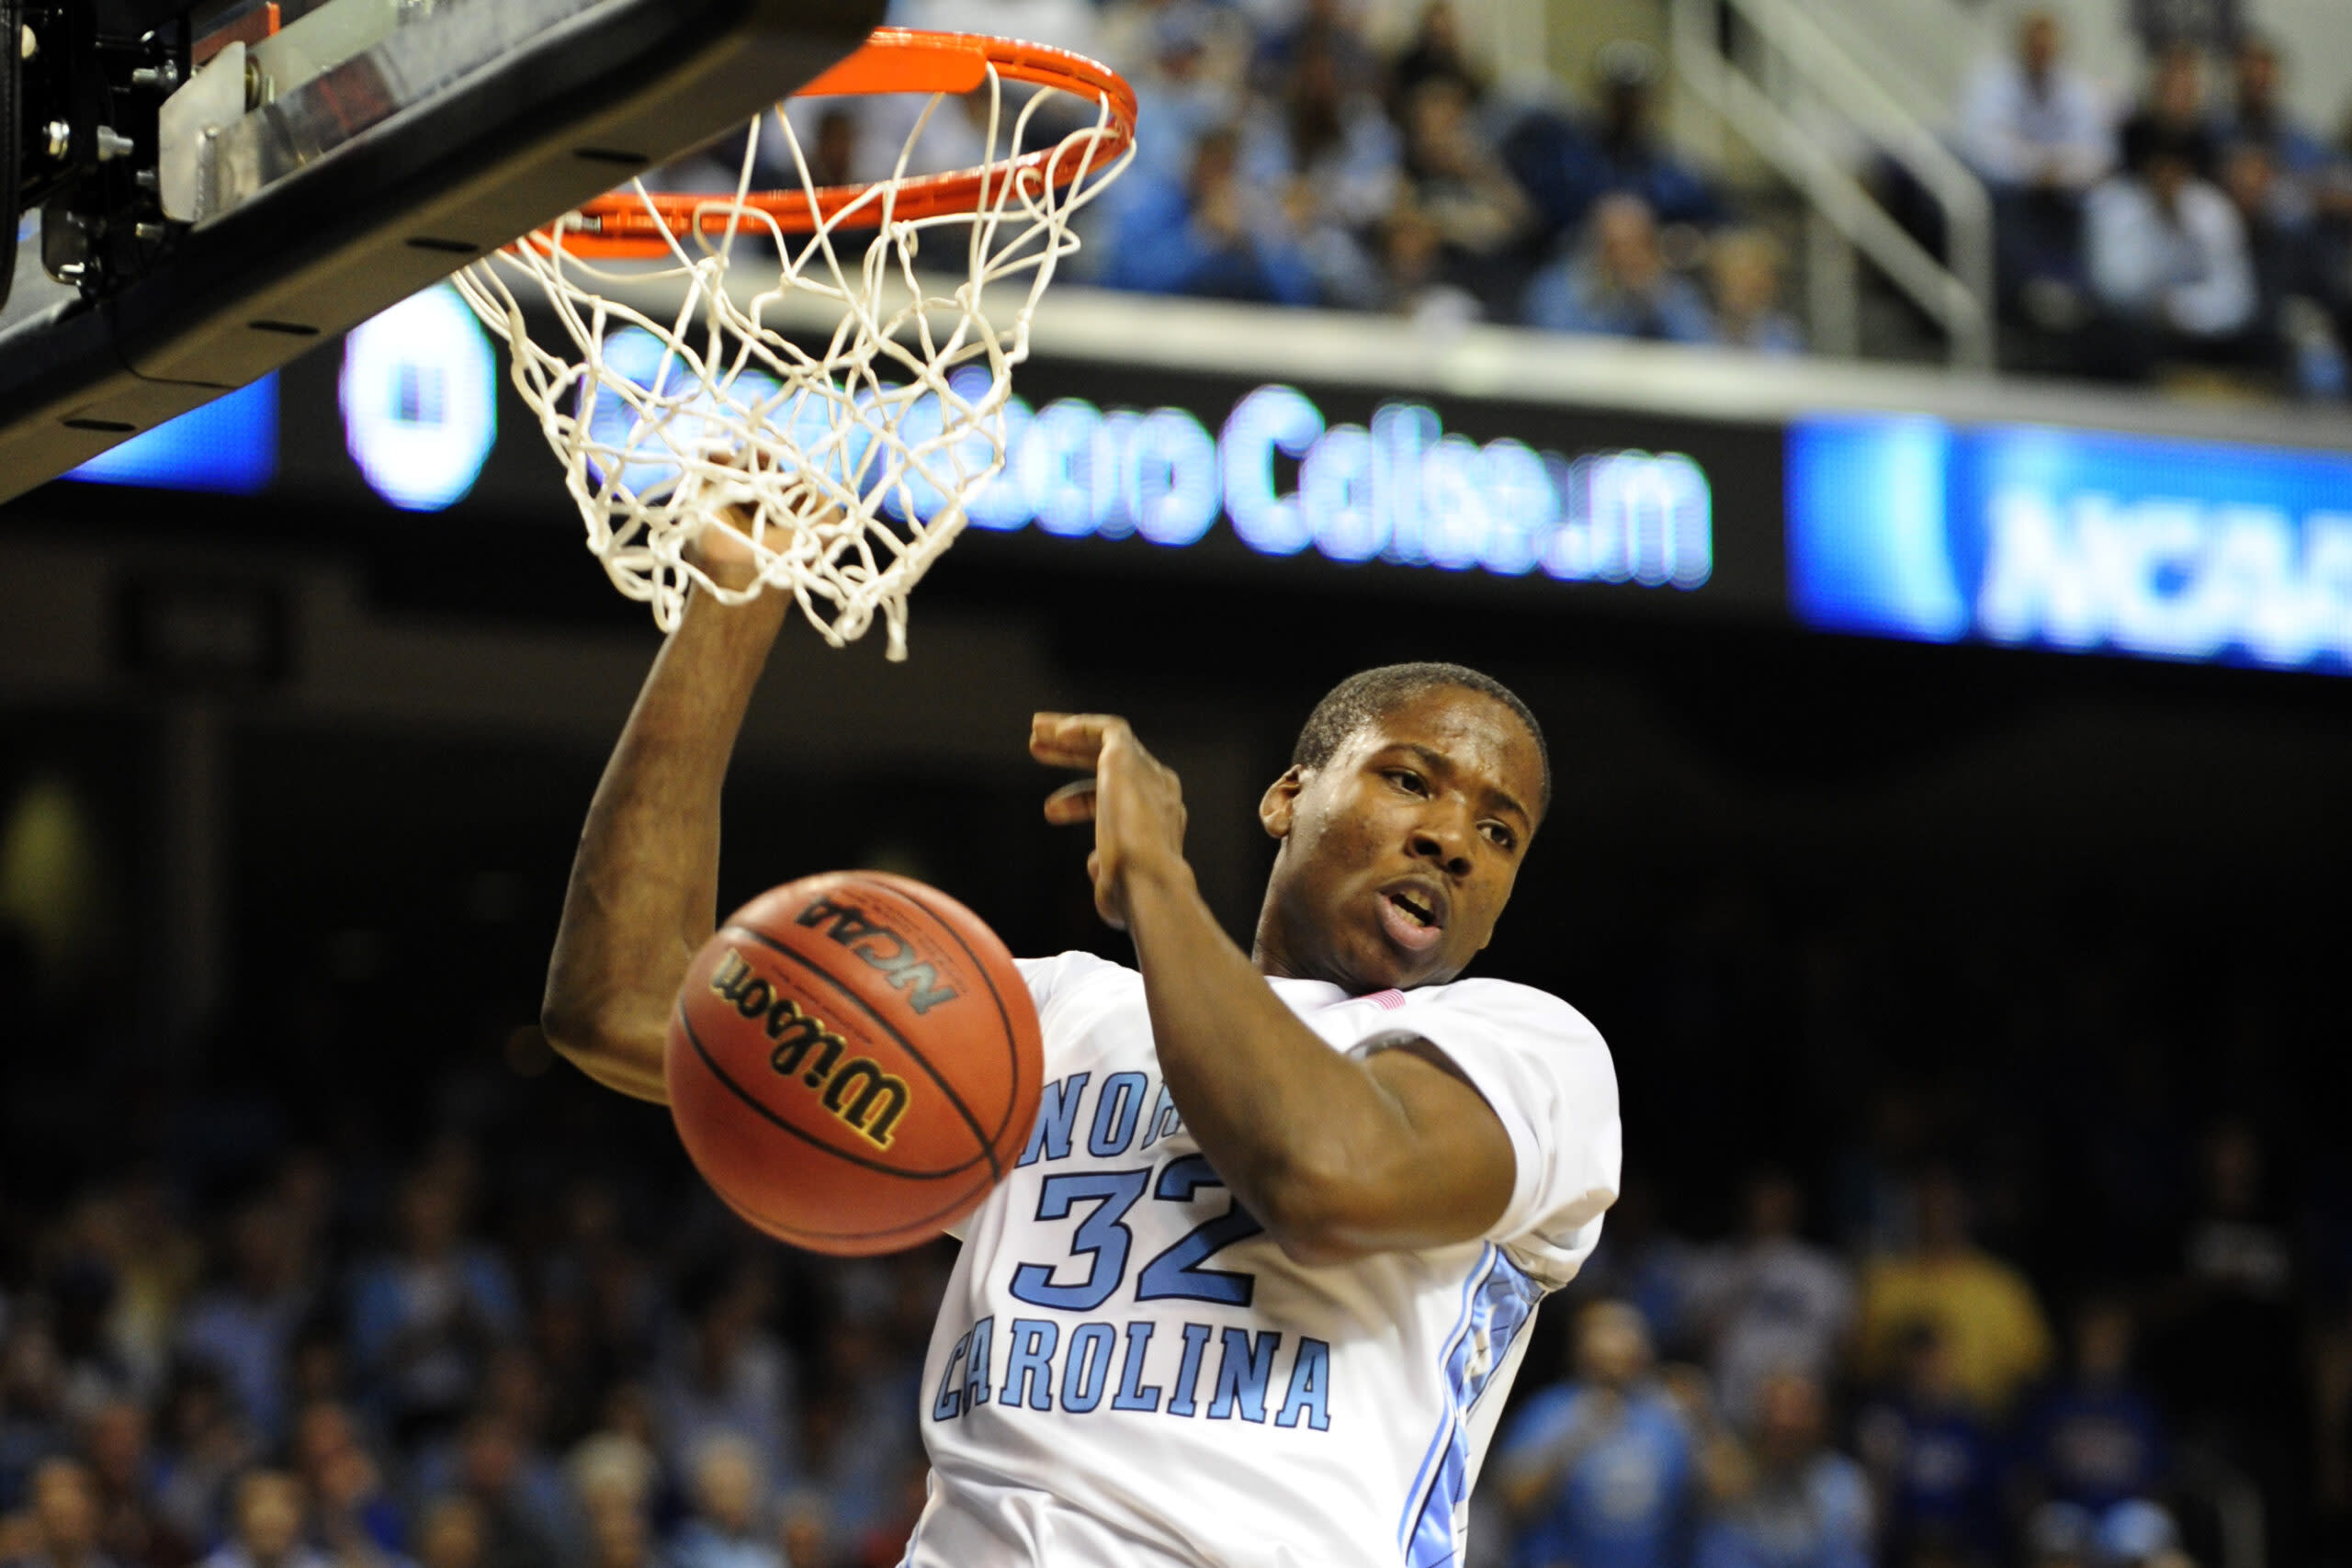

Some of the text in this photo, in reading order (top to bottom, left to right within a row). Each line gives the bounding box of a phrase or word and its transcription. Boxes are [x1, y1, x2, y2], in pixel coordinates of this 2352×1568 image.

[796, 895, 959, 1015] NCAA
[710, 947, 911, 1151] Wilson
[1009, 1153, 1265, 1313] 32
[933, 1314, 1331, 1432] CAROLINA
